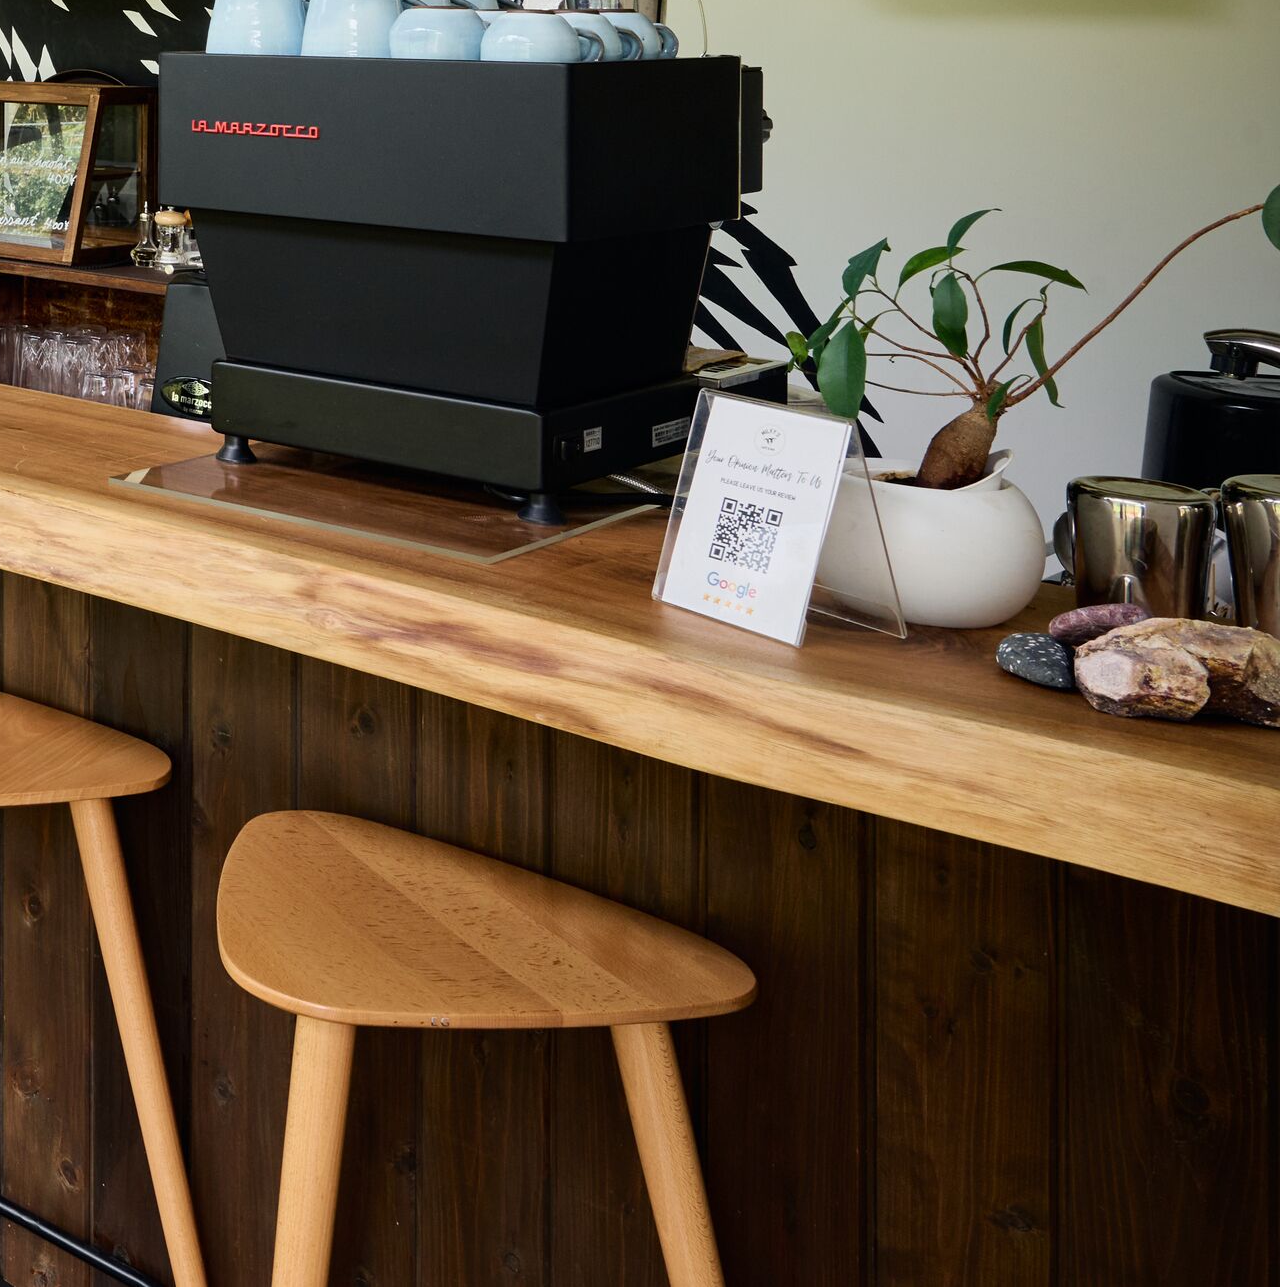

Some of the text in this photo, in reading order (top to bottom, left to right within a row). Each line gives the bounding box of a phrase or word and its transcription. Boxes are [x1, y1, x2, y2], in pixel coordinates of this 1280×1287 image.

[191, 119, 318, 139] LA MARZOCCO
[171, 391, 179, 402] la
[705, 450, 823, 489] Your Opinion Matters To Us
[720, 477, 739, 487] PLEASE
[739, 481, 757, 492] LEAVE
[765, 488, 779, 496] YOUR
[778, 492, 797, 501] REVIEW
[707, 571, 758, 598] Google
